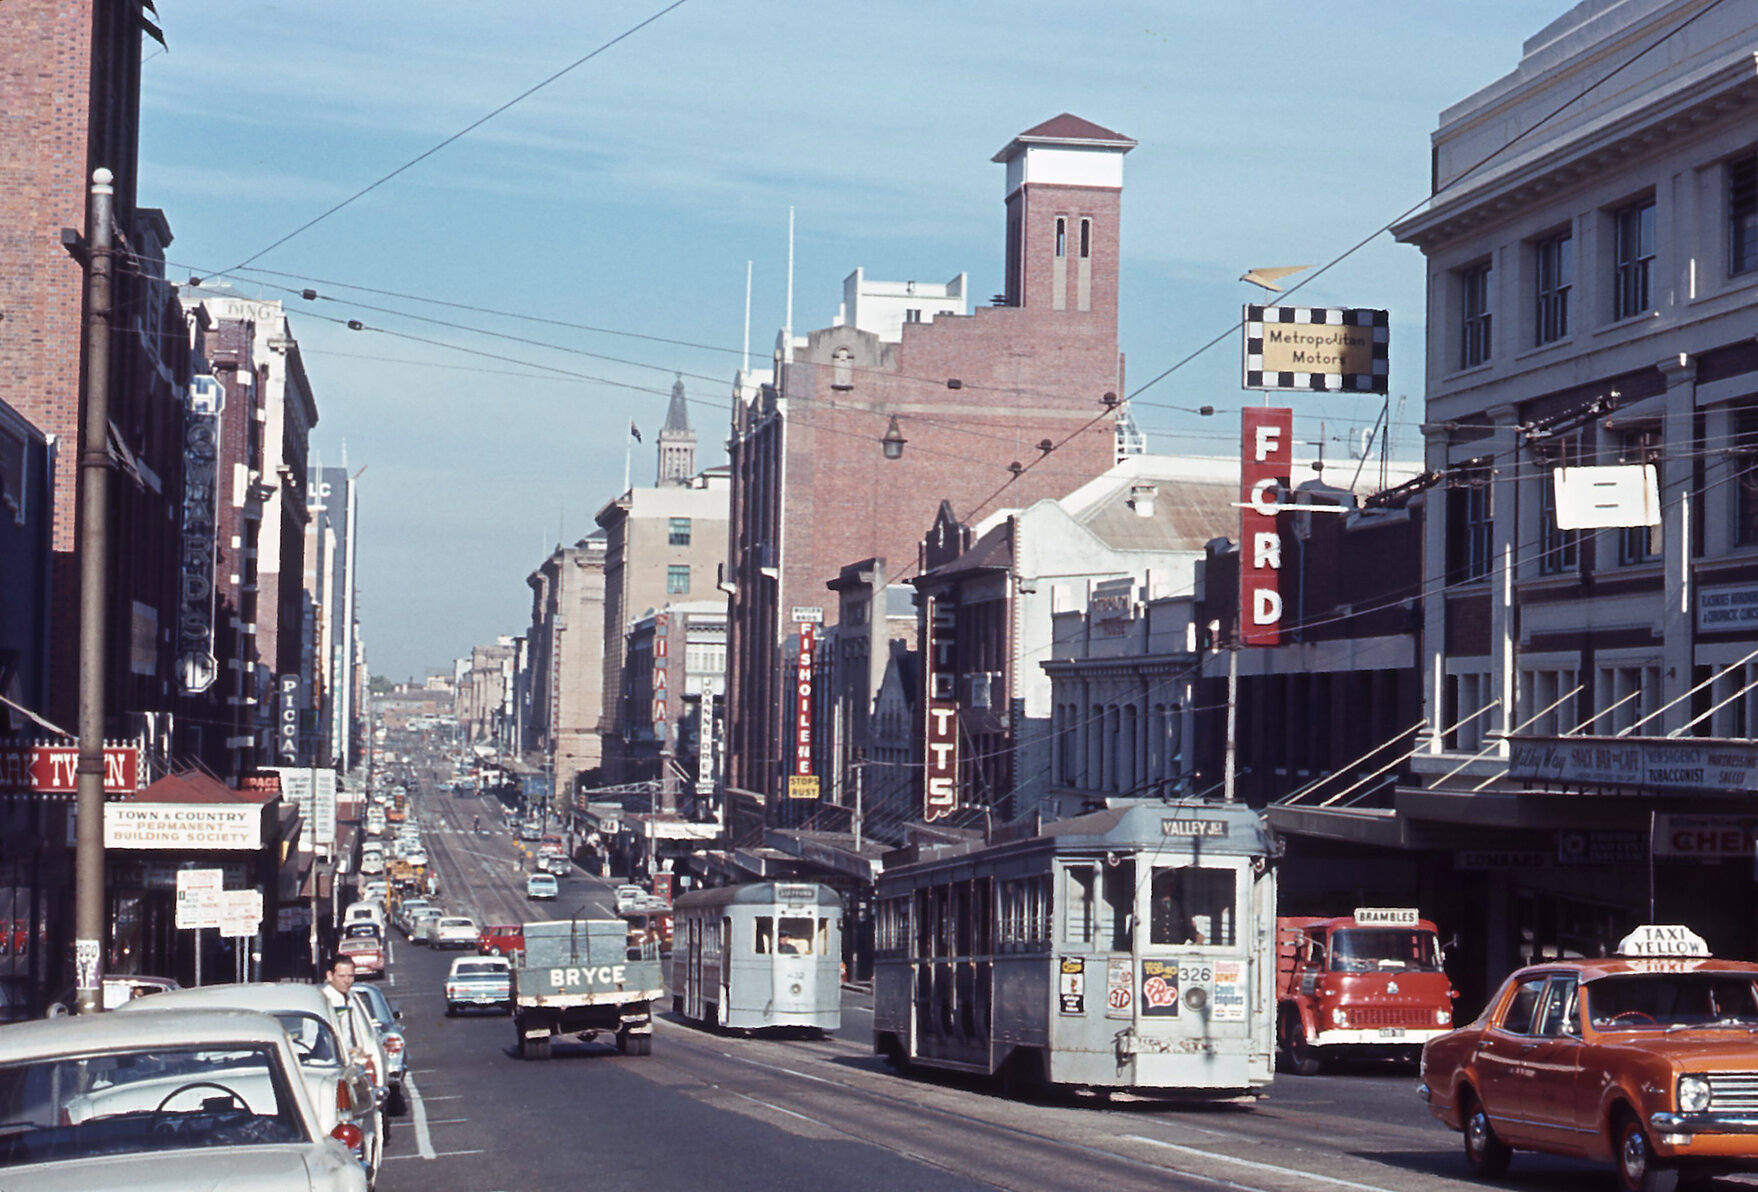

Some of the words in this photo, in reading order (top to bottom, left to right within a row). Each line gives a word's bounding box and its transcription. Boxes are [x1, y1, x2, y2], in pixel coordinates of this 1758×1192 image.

[1270, 330, 1366, 348] Metropolitan
[1292, 351, 1346, 365] Motors
[1250, 425, 1283, 626] FORD
[702, 679, 712, 736] JOANNE
[930, 602, 956, 806] STOTTS
[1543, 745, 1567, 778] Way
[1595, 750, 1612, 769] BAR
[50, 753, 126, 787] TWN
[1649, 767, 1705, 784] TOBACCONIST
[790, 776, 820, 786] STOPS
[791, 788, 817, 797] RUST
[117, 811, 159, 820] TOWN
[175, 812, 248, 822] COUNTRY
[136, 821, 225, 832] PERMANENT
[1163, 821, 1207, 836] VALLEY
[113, 831, 180, 841] BUILDING
[187, 832, 249, 842] SOCIETY
[1359, 911, 1415, 922] BRAMBLES
[1644, 928, 1686, 941] TAXI
[1634, 941, 1700, 954] YELLOW
[549, 965, 627, 987] BRYCE
[1179, 967, 1212, 982] 326
[1110, 989, 1129, 1007] STP
